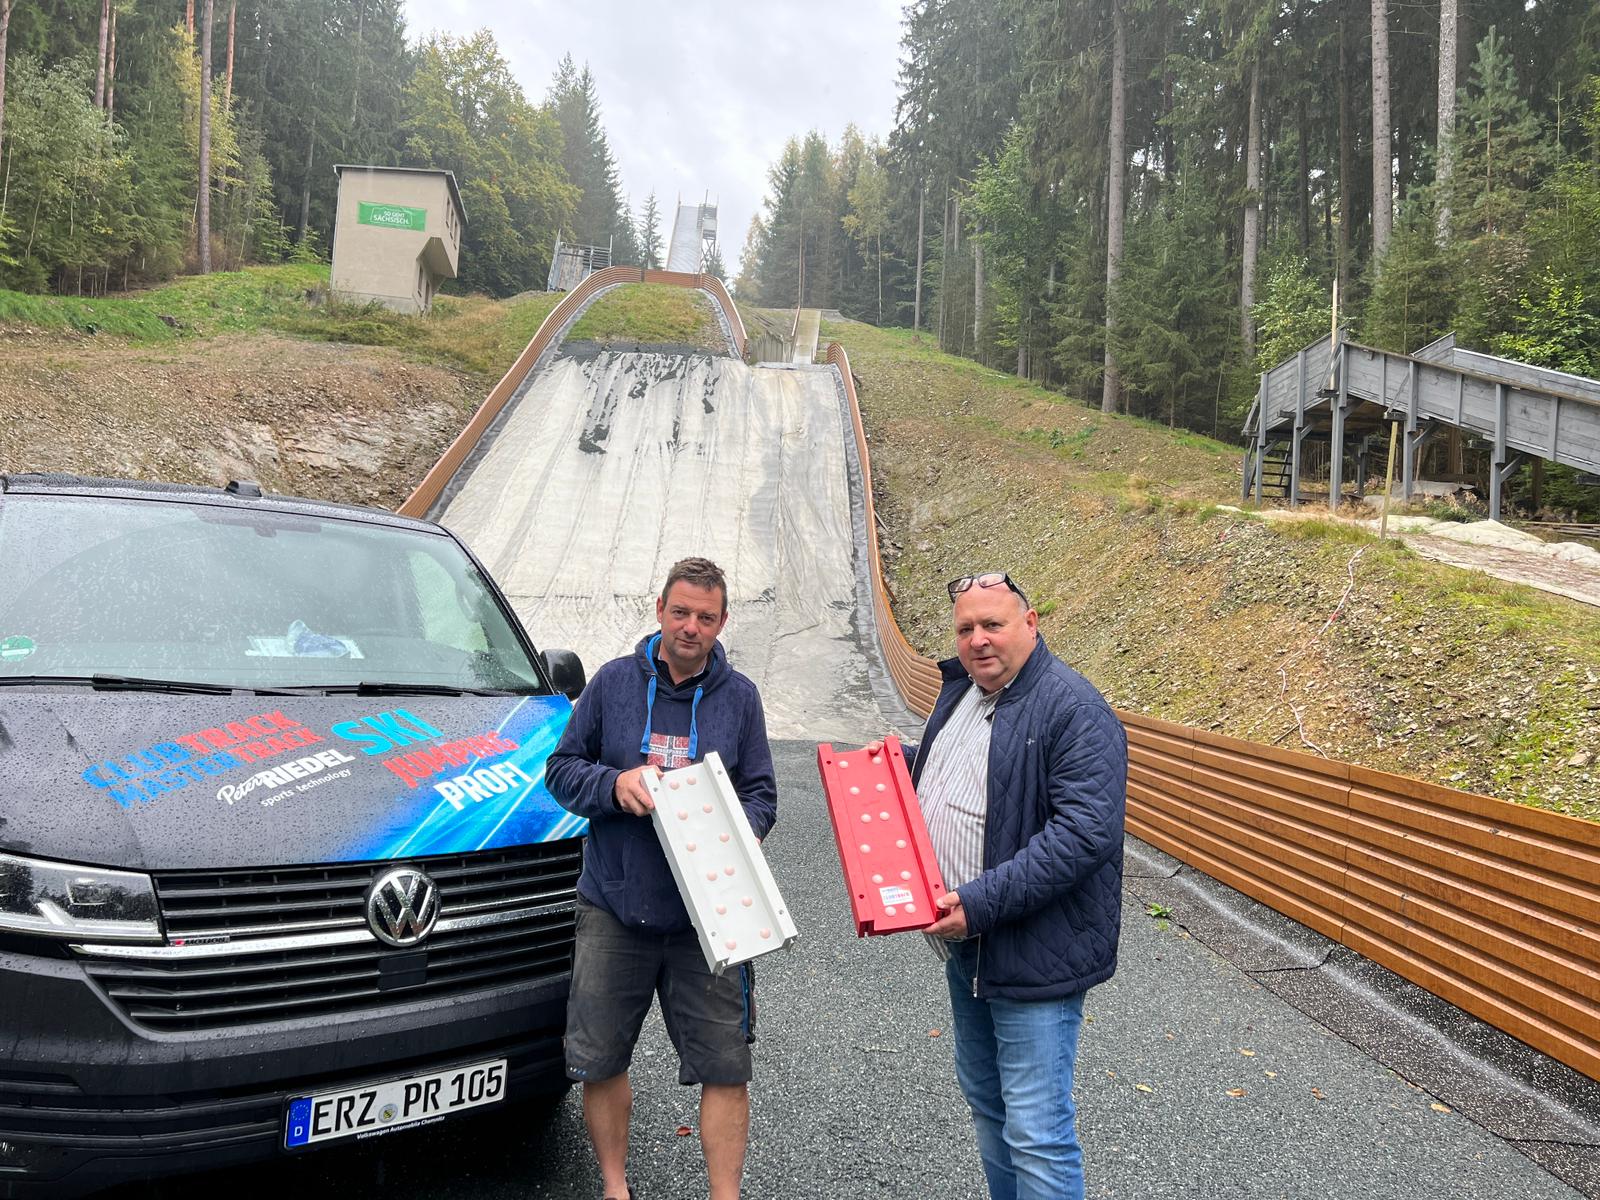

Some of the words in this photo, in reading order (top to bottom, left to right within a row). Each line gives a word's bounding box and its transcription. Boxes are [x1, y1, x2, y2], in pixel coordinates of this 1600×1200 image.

[330, 708, 444, 756] SKI
[382, 731, 520, 789] JUMPING
[260, 788, 295, 807] sports
[295, 768, 352, 792] technology
[433, 761, 534, 811] PROFI
[312, 1091, 377, 1136] ERZ
[403, 1078, 441, 1118] PR
[449, 1065, 503, 1107] 105
[294, 1126, 303, 1137] D
[356, 1127, 390, 1140] Volkswagen
[390, 1121, 420, 1133] Automobile
